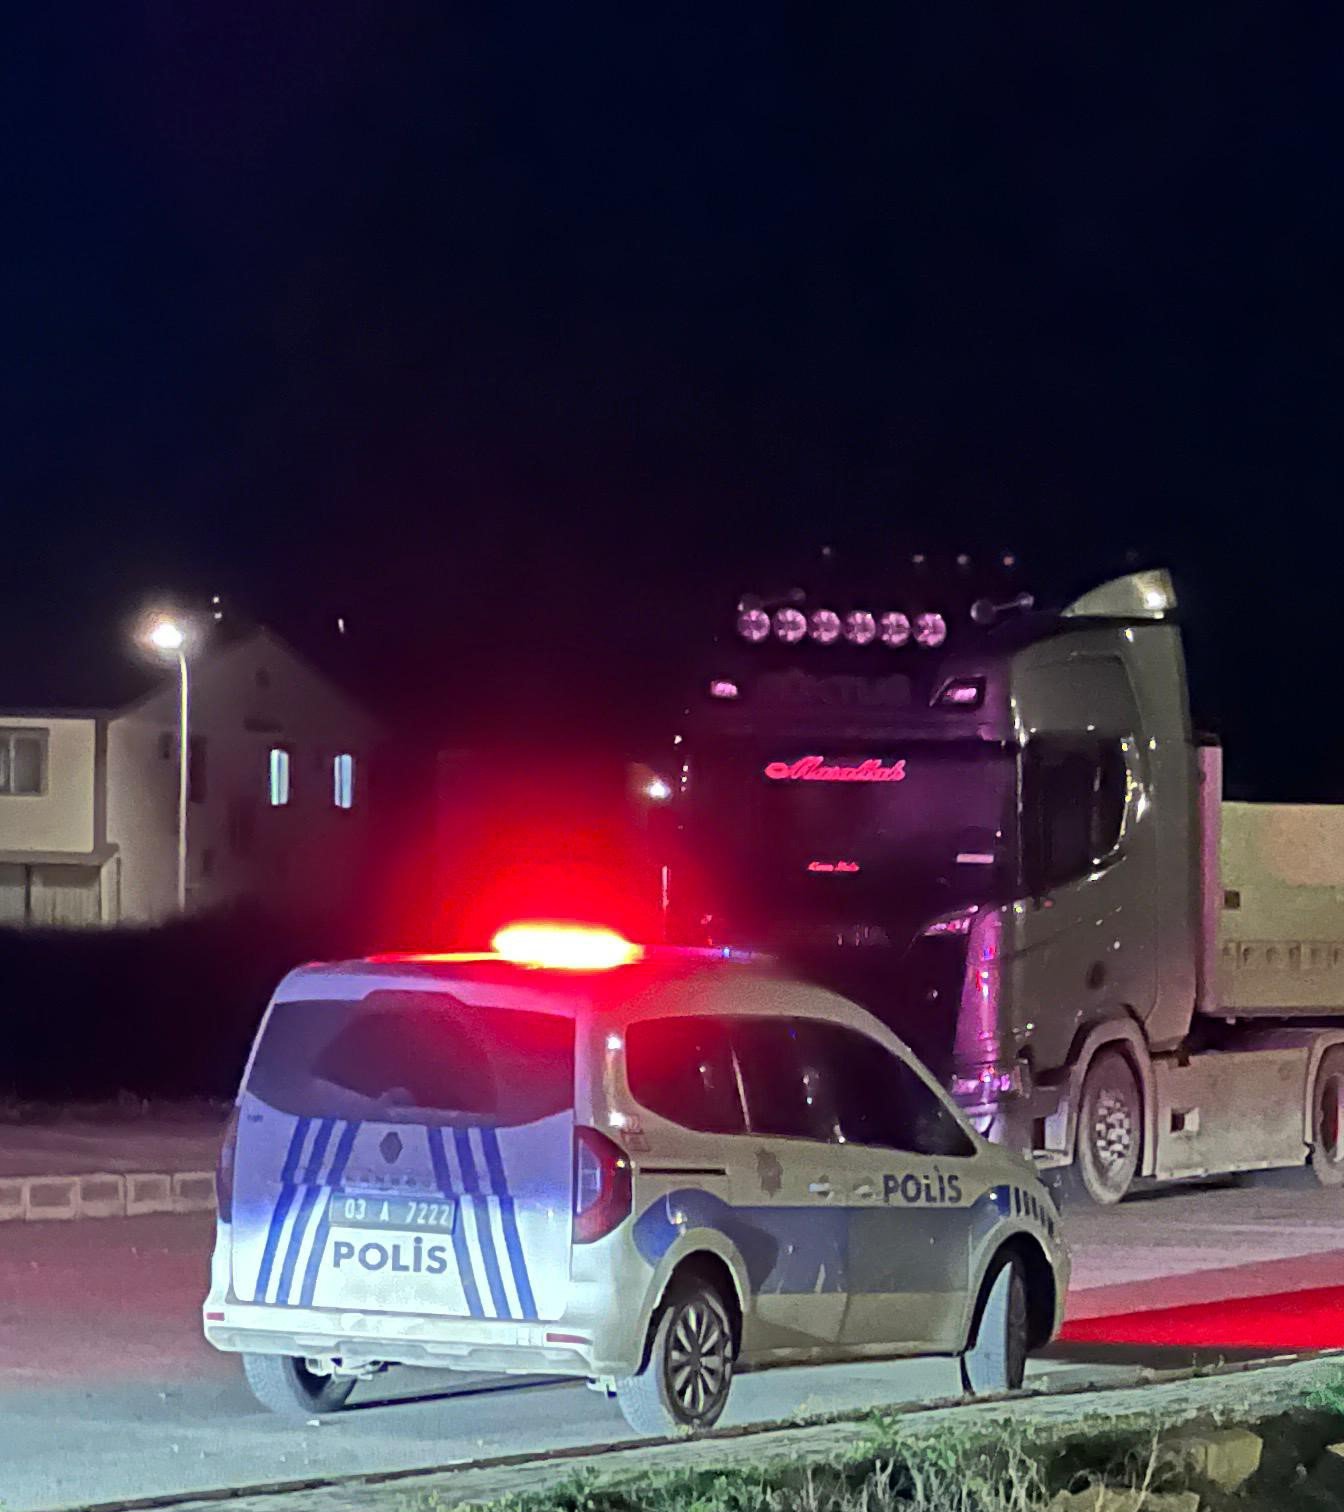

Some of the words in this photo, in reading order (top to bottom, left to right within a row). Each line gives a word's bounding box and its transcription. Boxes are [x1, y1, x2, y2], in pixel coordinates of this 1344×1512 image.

[344, 1198, 367, 1220] 03
[379, 1200, 390, 1222] A
[405, 1201, 450, 1226] 7222
[332, 1236, 448, 1274] POLİS
